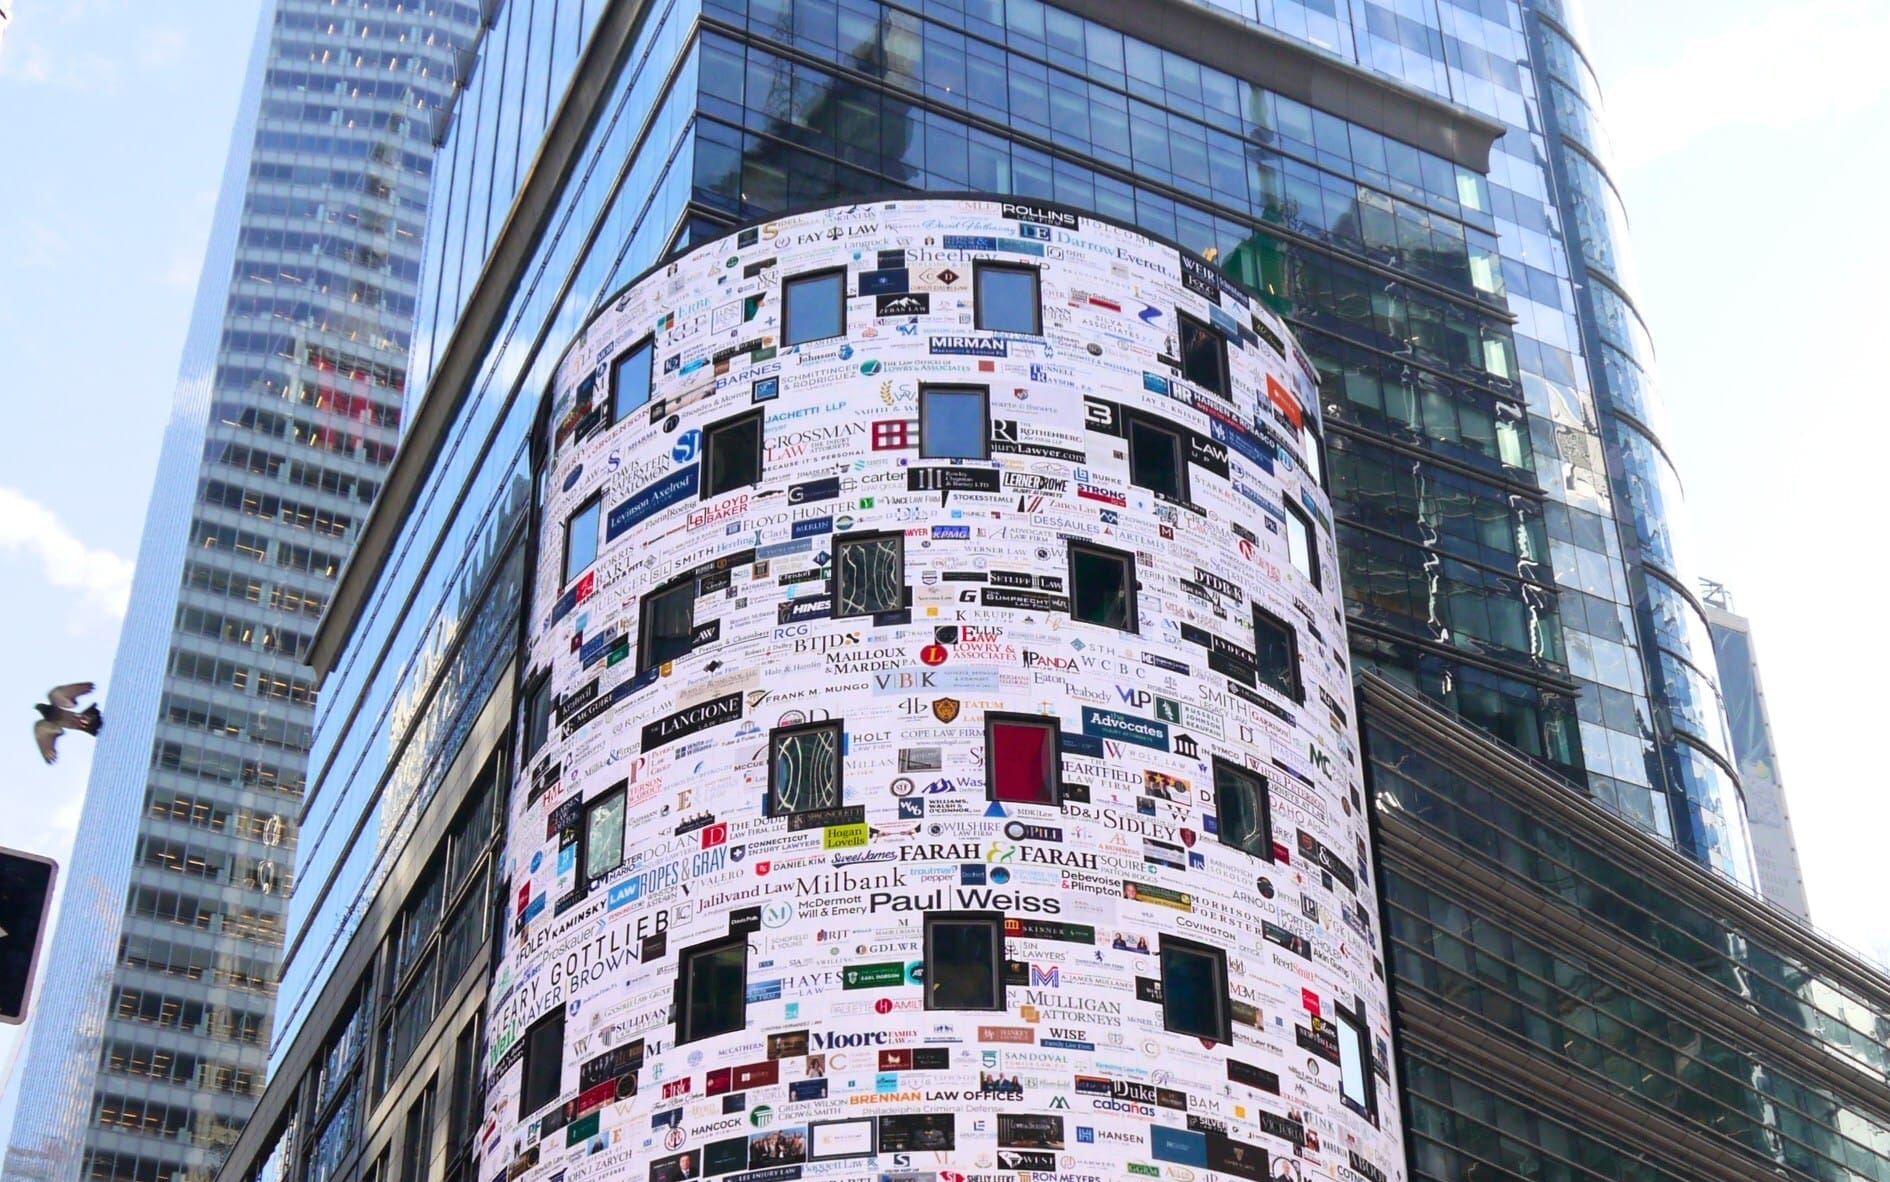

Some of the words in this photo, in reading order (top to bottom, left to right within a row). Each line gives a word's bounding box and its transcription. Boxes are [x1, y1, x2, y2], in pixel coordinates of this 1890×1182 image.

[1003, 204, 1075, 225] ROLLINS
[797, 230, 822, 245] FAY
[847, 224, 879, 236] LAW
[931, 336, 1005, 350] MIRMAN
[716, 361, 782, 389] BARNES
[764, 405, 821, 424] JACHETTI
[825, 401, 847, 413] LLP
[764, 422, 867, 450] GROSSMAN
[1191, 436, 1229, 463] LAW
[861, 472, 905, 484] carter
[1092, 472, 1122, 485] BURKE
[1078, 483, 1126, 500] STRONG
[610, 498, 651, 529] Levinson
[706, 494, 749, 515] LLOYD
[707, 504, 749, 524] BAKER
[792, 502, 855, 521] HUNTER
[932, 526, 970, 539] KPMG
[1034, 514, 1099, 535] DESSAULES
[675, 546, 714, 569] SMITH
[774, 625, 808, 639] RCG
[794, 634, 844, 655] BTJD
[953, 643, 1000, 653] LOWRY
[825, 647, 906, 664] MAILLOUX
[1028, 651, 1080, 671] PANDA
[834, 660, 900, 675] MARDEN
[1034, 672, 1066, 685] Eaton
[765, 691, 805, 705] FRANK
[825, 682, 869, 693] MUNGO
[1065, 683, 1112, 704] Peabody
[1198, 683, 1248, 716] SMITH
[661, 696, 740, 736] LANCIONE
[1090, 713, 1164, 739] Advocates
[853, 732, 892, 743] HOLT
[828, 827, 862, 839] Hogan
[1103, 809, 1176, 842] SIDLEY
[642, 831, 699, 862] DOLAN
[828, 837, 865, 849] Lovells
[898, 843, 982, 861] FARAH
[773, 859, 807, 871] DANIEL
[808, 857, 826, 866] KIM
[1019, 846, 1098, 870] FARAH
[1100, 859, 1147, 874] SQUIRE
[639, 862, 680, 898] ROPES
[693, 846, 728, 872] GRAY
[921, 874, 955, 883] pepper
[1061, 870, 1121, 887] Debevoise
[765, 882, 795, 895] Law
[795, 867, 908, 898] Milbank
[1071, 882, 1122, 898] Plimpton
[609, 884, 637, 903] LAW
[799, 895, 862, 909] McDermott
[870, 889, 942, 913] Paul
[960, 889, 1061, 915] Weiss
[1232, 889, 1276, 914] ARNOLD
[552, 899, 607, 939] KAMINSKY
[799, 908, 818, 918] Will
[820, 908, 828, 916] &
[831, 905, 867, 918] Emery
[1191, 894, 1262, 924] MORRISON
[1175, 915, 1237, 942] COVINGTON
[1191, 905, 1263, 936] FOERSTER
[1280, 909, 1315, 933] PORTER
[519, 924, 552, 964] FOLEY
[829, 929, 849, 940] RJT
[542, 926, 595, 967] Proskauer
[551, 909, 669, 985] GOTTLIEB
[869, 942, 918, 953] GDLWR
[1023, 949, 1066, 961] LAWYERS
[517, 985, 562, 1029] MAYER
[570, 943, 639, 994] BROWN
[782, 971, 842, 990] HAYES
[1025, 990, 1121, 1015] MULLIGAN
[1042, 1010, 1121, 1027] ATTORNEYS
[812, 1030, 888, 1051] Moore
[1050, 1027, 1087, 1040] WISE
[1005, 1052, 1068, 1064] SANDOVAL
[849, 1091, 921, 1105] BRENNAN
[925, 1091, 959, 1102] LAW
[963, 1090, 1024, 1102] OFFICES
[1114, 1080, 1156, 1101] Duke
[1093, 1098, 1156, 1118] cabañas
[1190, 1095, 1220, 1112] BAM
[691, 1118, 742, 1136] HANCOCK
[1098, 1130, 1144, 1144] HANSEN
[1032, 1173, 1058, 1181] RON
